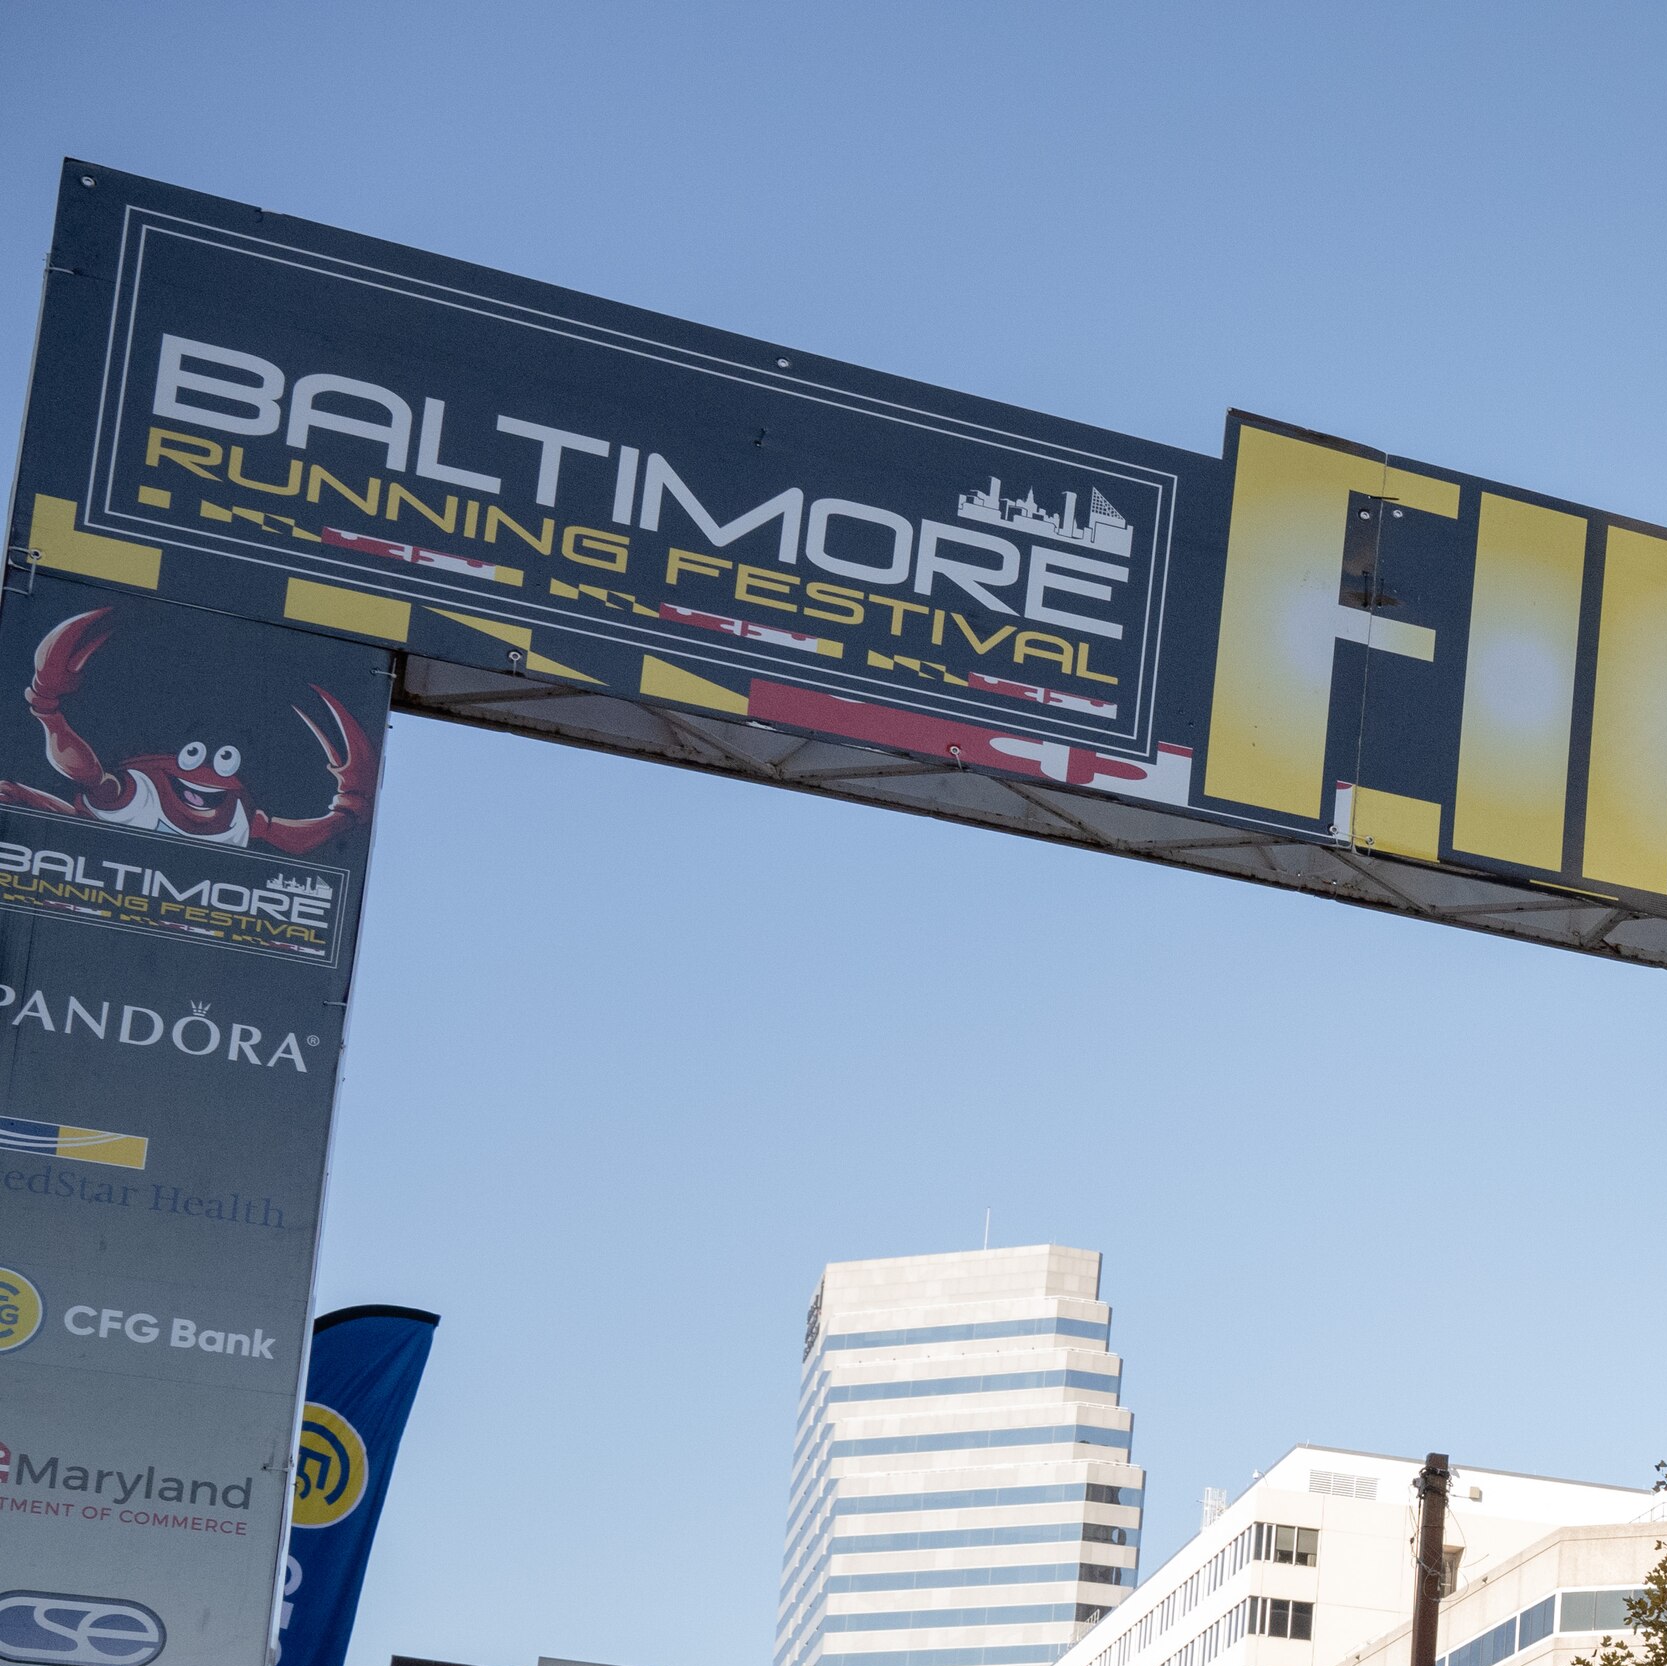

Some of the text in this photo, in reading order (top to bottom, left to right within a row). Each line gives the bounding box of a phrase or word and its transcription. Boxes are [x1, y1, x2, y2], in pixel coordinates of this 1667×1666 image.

[152, 333, 1131, 640] BALTIMORE
[145, 427, 1119, 686] RUNNING FESTIVAL
[160, 901, 327, 945] FESTIVAL
[150, 1183, 285, 1230] Health
[64, 1304, 160, 1344] CFG
[170, 1317, 277, 1361] Bank
[15, 1453, 253, 1511] Maryland
[82, 1505, 113, 1521] OF
[119, 1509, 248, 1536] COMMERCE
